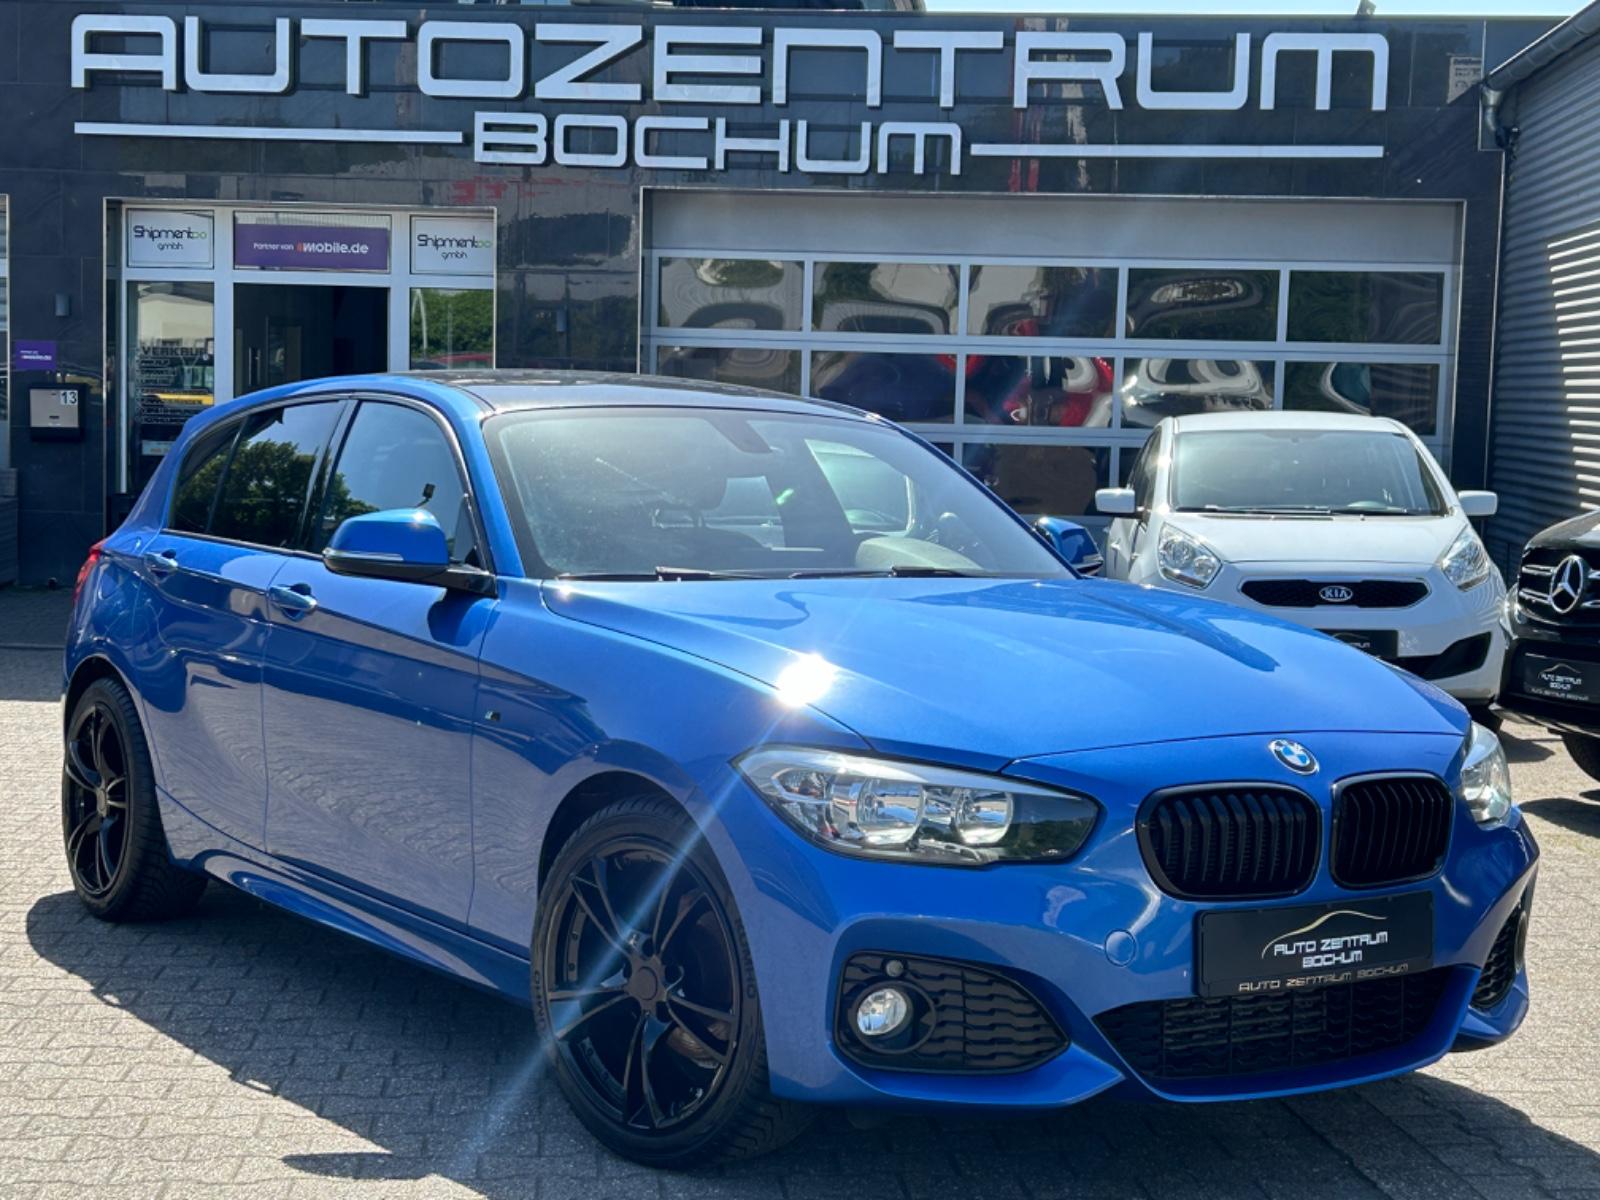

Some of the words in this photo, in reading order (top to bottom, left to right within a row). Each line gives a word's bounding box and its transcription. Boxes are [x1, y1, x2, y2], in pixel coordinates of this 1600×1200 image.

[71, 14, 1390, 111] AUTOZENTRUM
[473, 111, 962, 175] BOCHUM
[62, 391, 77, 404] 13
[1325, 588, 1349, 598] KIA
[1273, 941, 1316, 956] AUTO
[1320, 931, 1388, 951] ZENTRUM
[1302, 950, 1363, 968] BOCHUM
[1238, 979, 1281, 992] AUTO
[1286, 972, 1352, 987] ZENTRUM
[1356, 963, 1409, 979] BOCHUM
